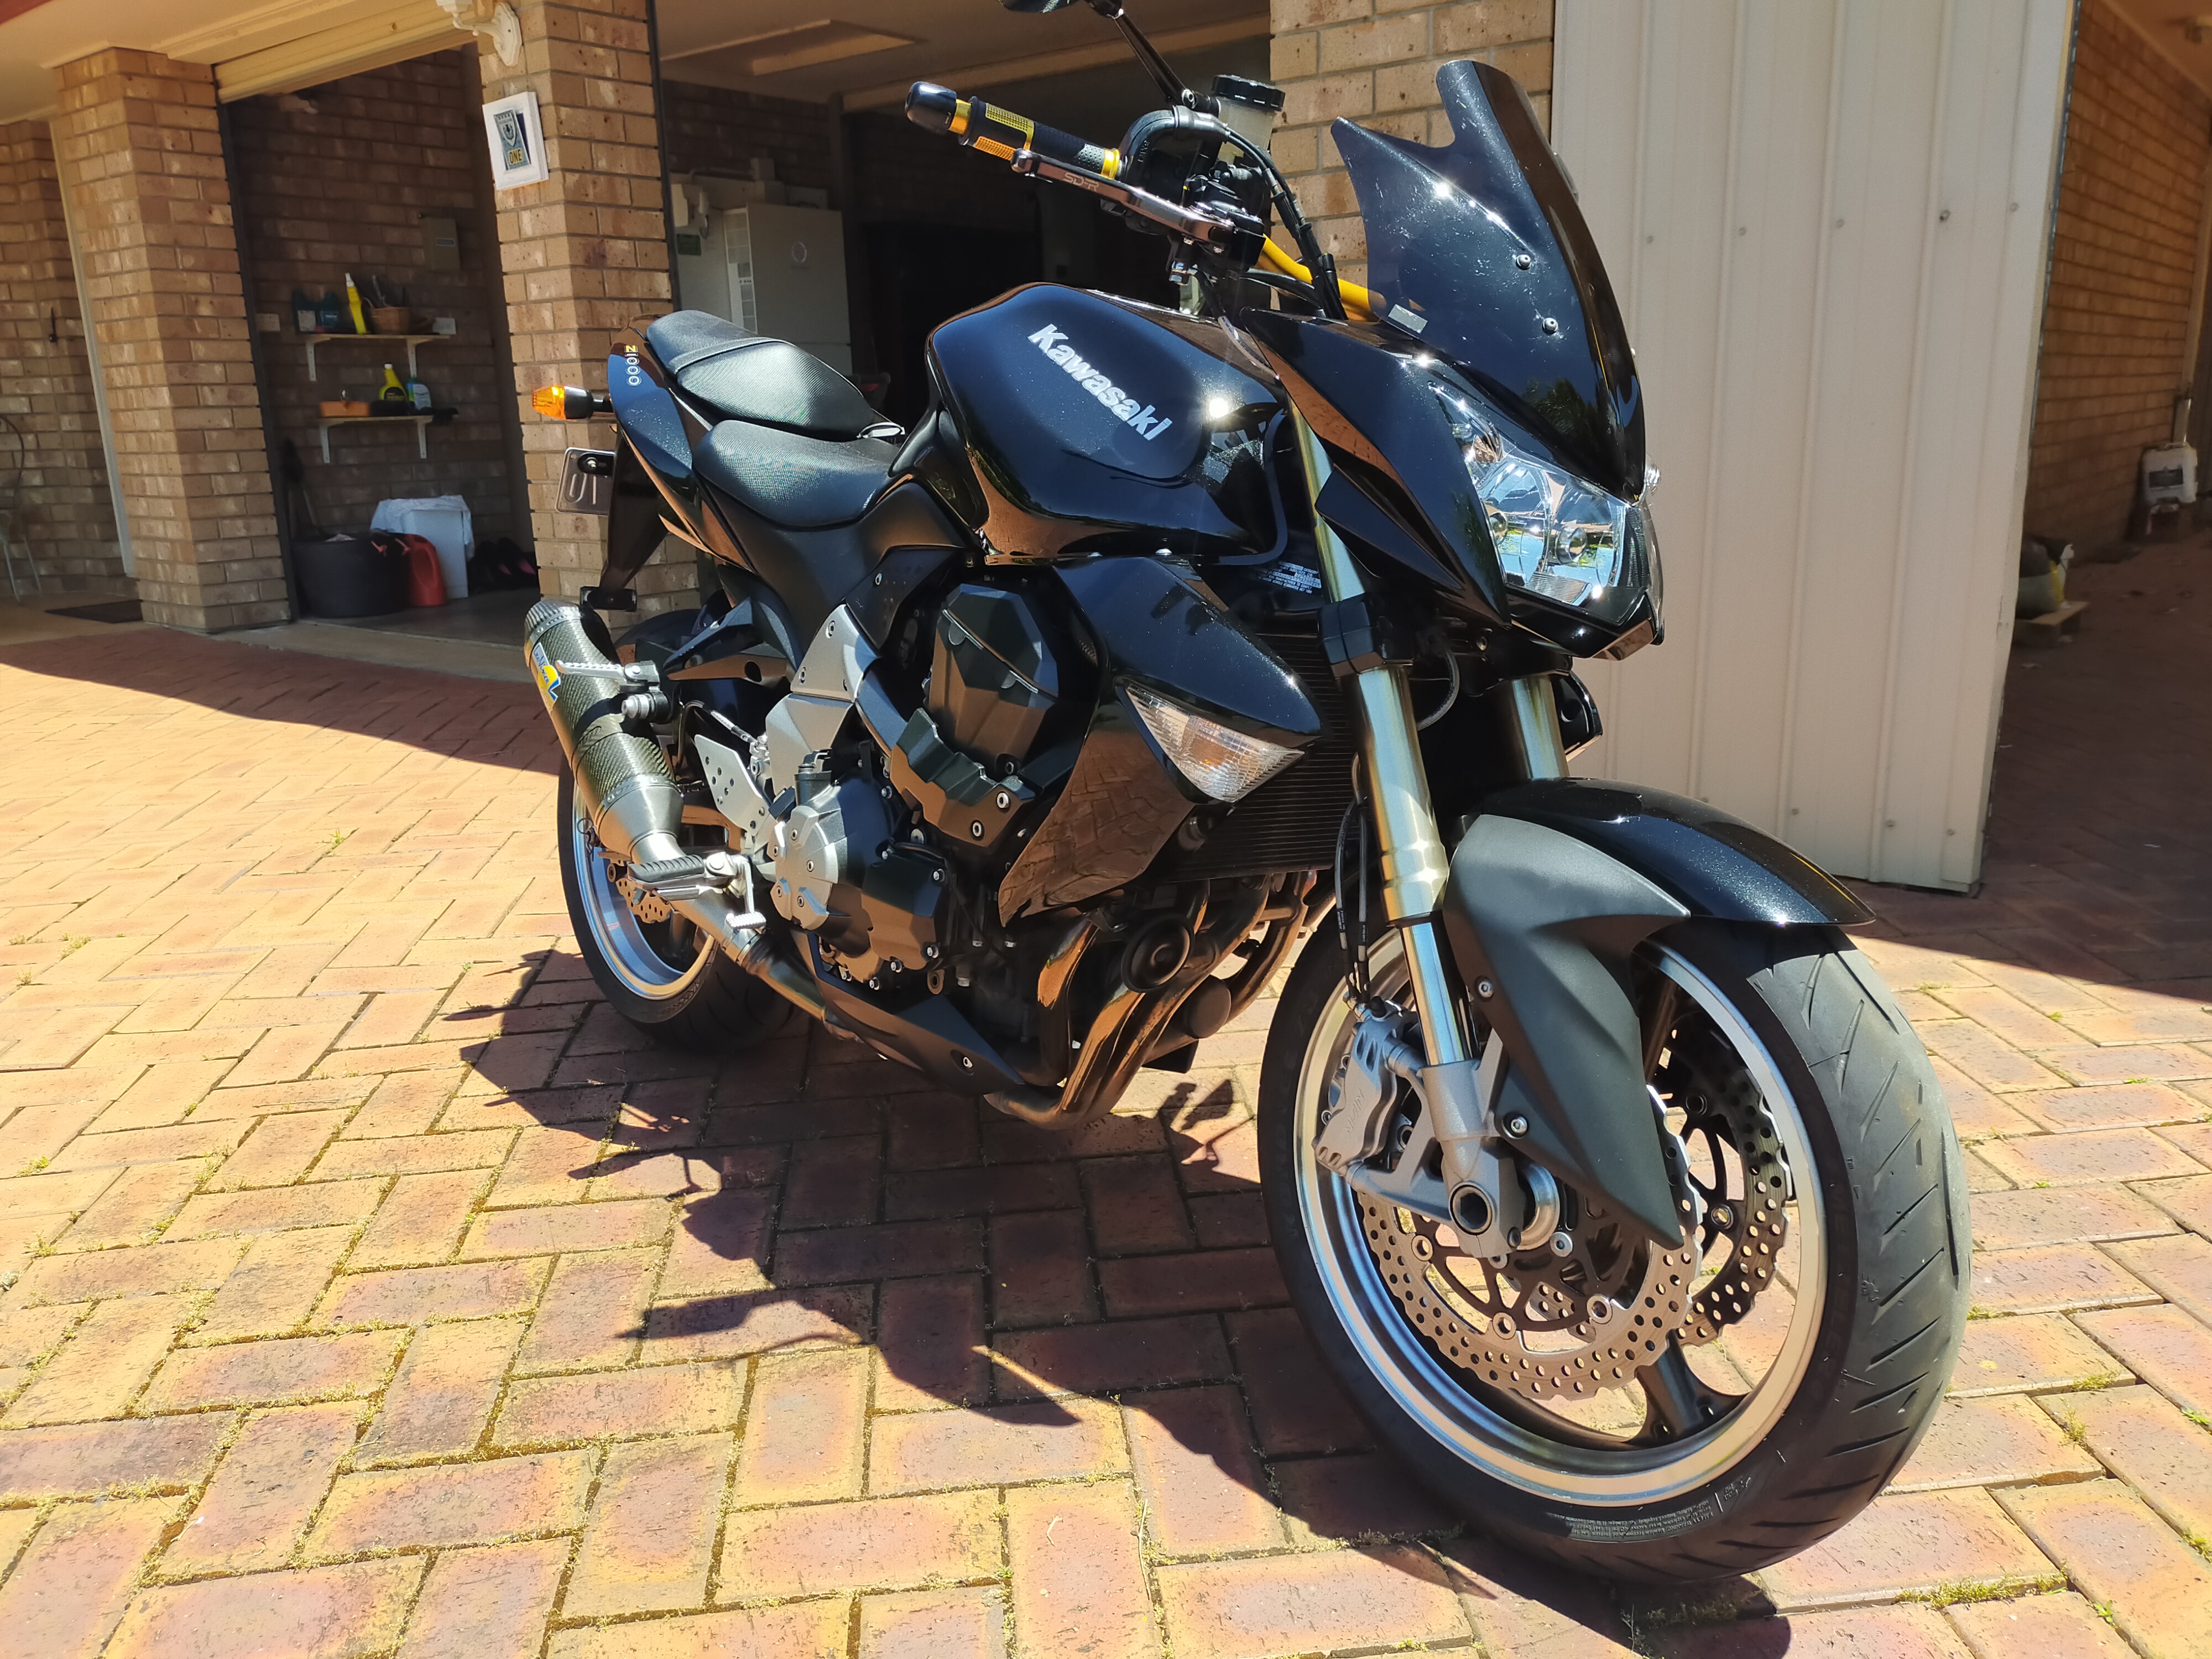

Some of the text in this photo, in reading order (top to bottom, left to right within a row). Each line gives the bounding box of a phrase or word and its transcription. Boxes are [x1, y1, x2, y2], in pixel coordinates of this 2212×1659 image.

[509, 149, 523, 164] ONE
[1063, 171, 1099, 191] SD-R
[624, 345, 641, 386] Z1000
[1027, 324, 1172, 441] Kawasaki
